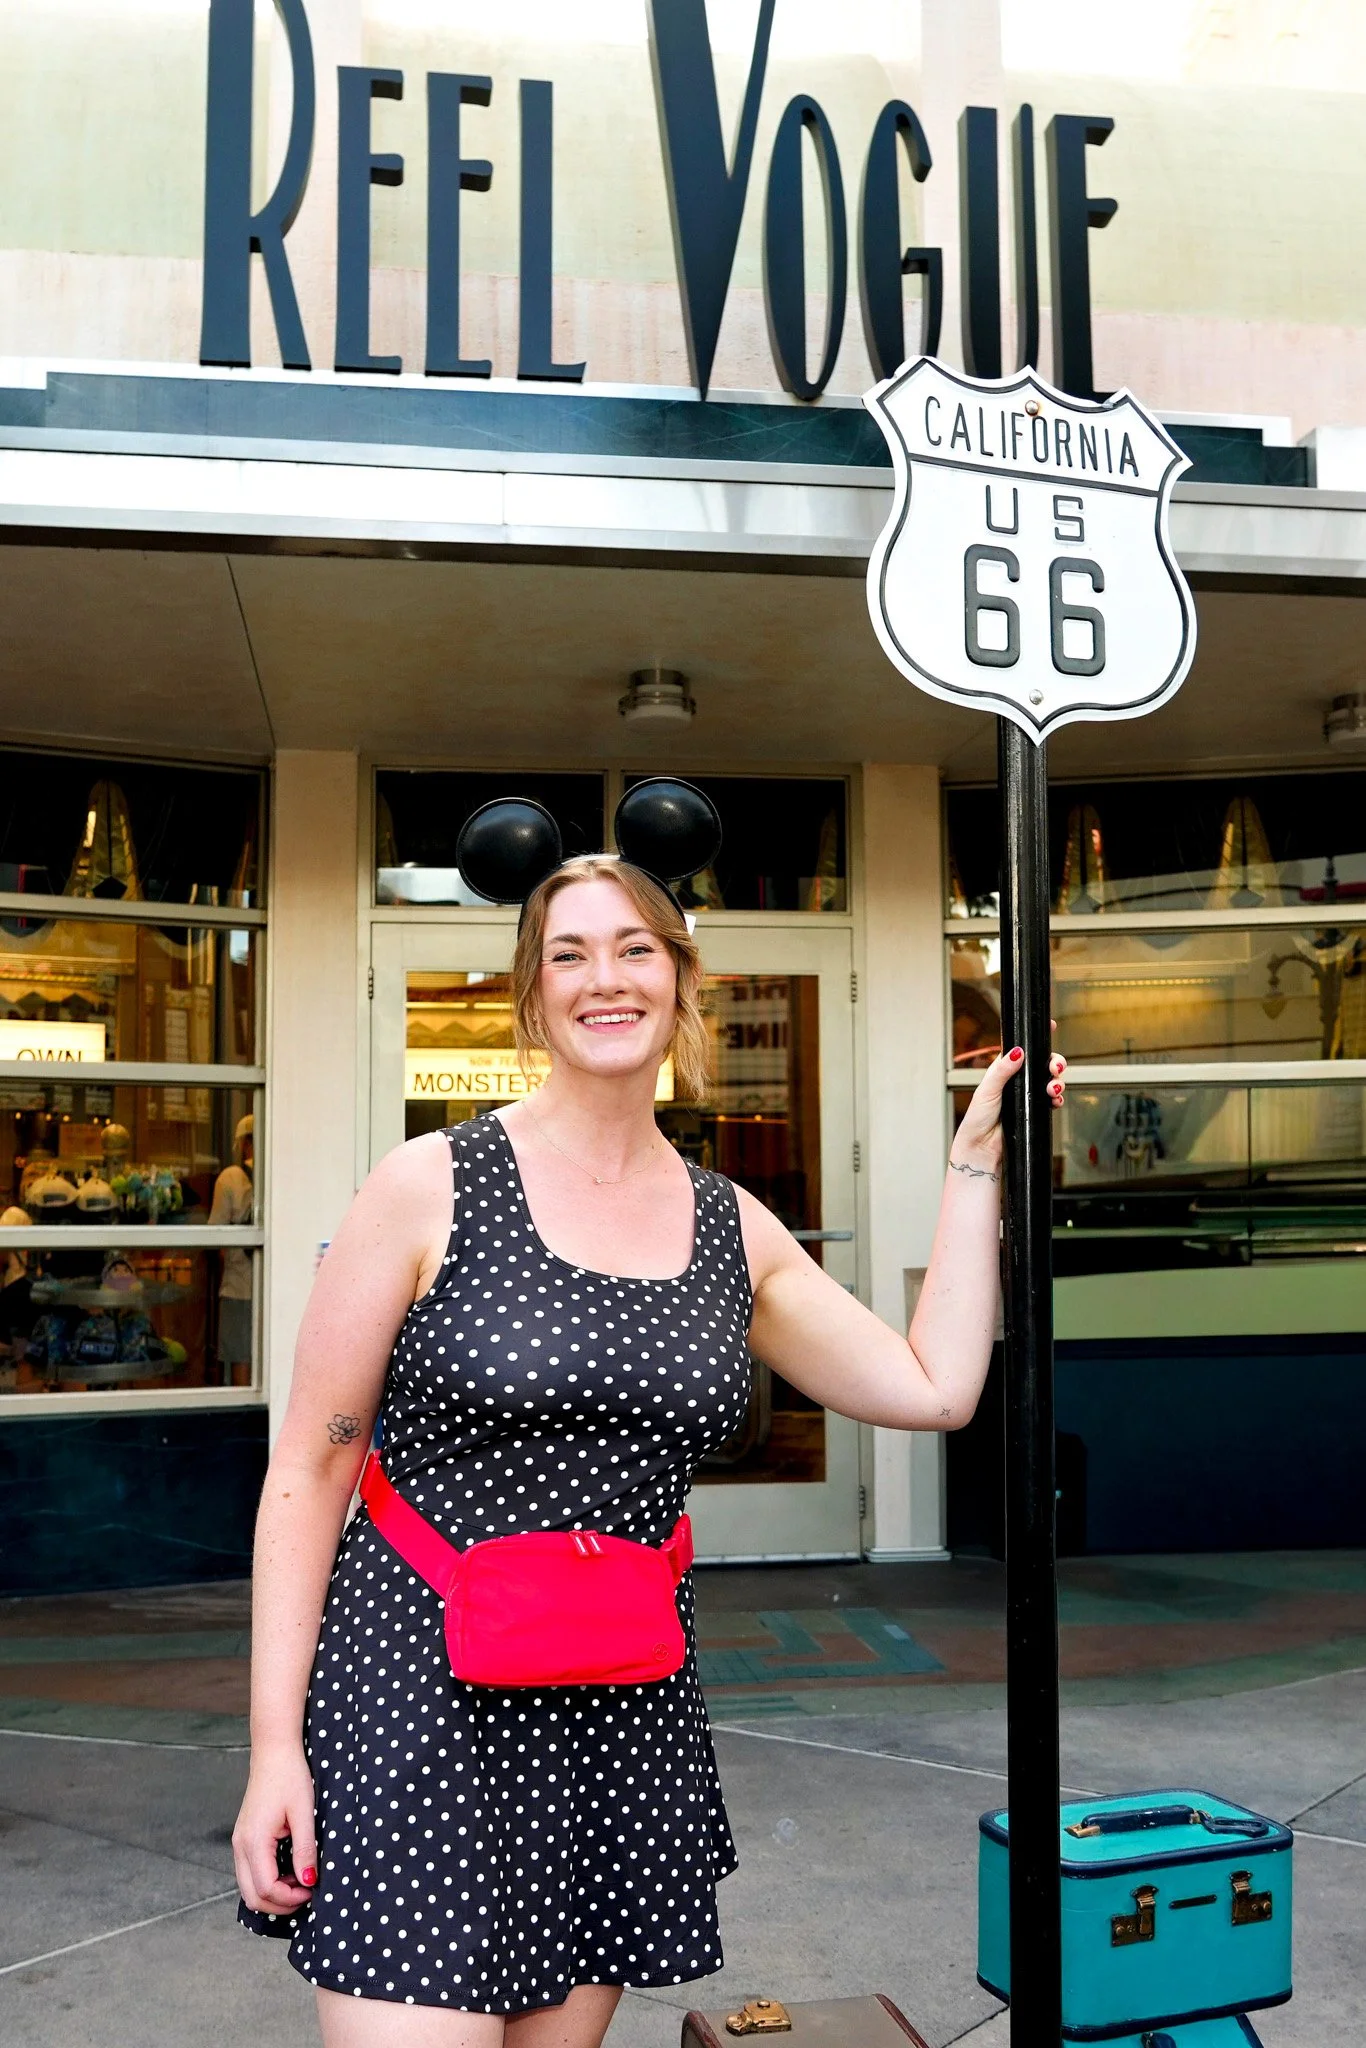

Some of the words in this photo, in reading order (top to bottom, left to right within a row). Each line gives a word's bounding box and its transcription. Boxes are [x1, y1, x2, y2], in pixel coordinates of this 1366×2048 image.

[200, 0, 586, 382] REEL
[645, 0, 1117, 401] VOGUE
[924, 396, 1139, 478] CALIFORNIA
[964, 543, 1106, 676] 66
